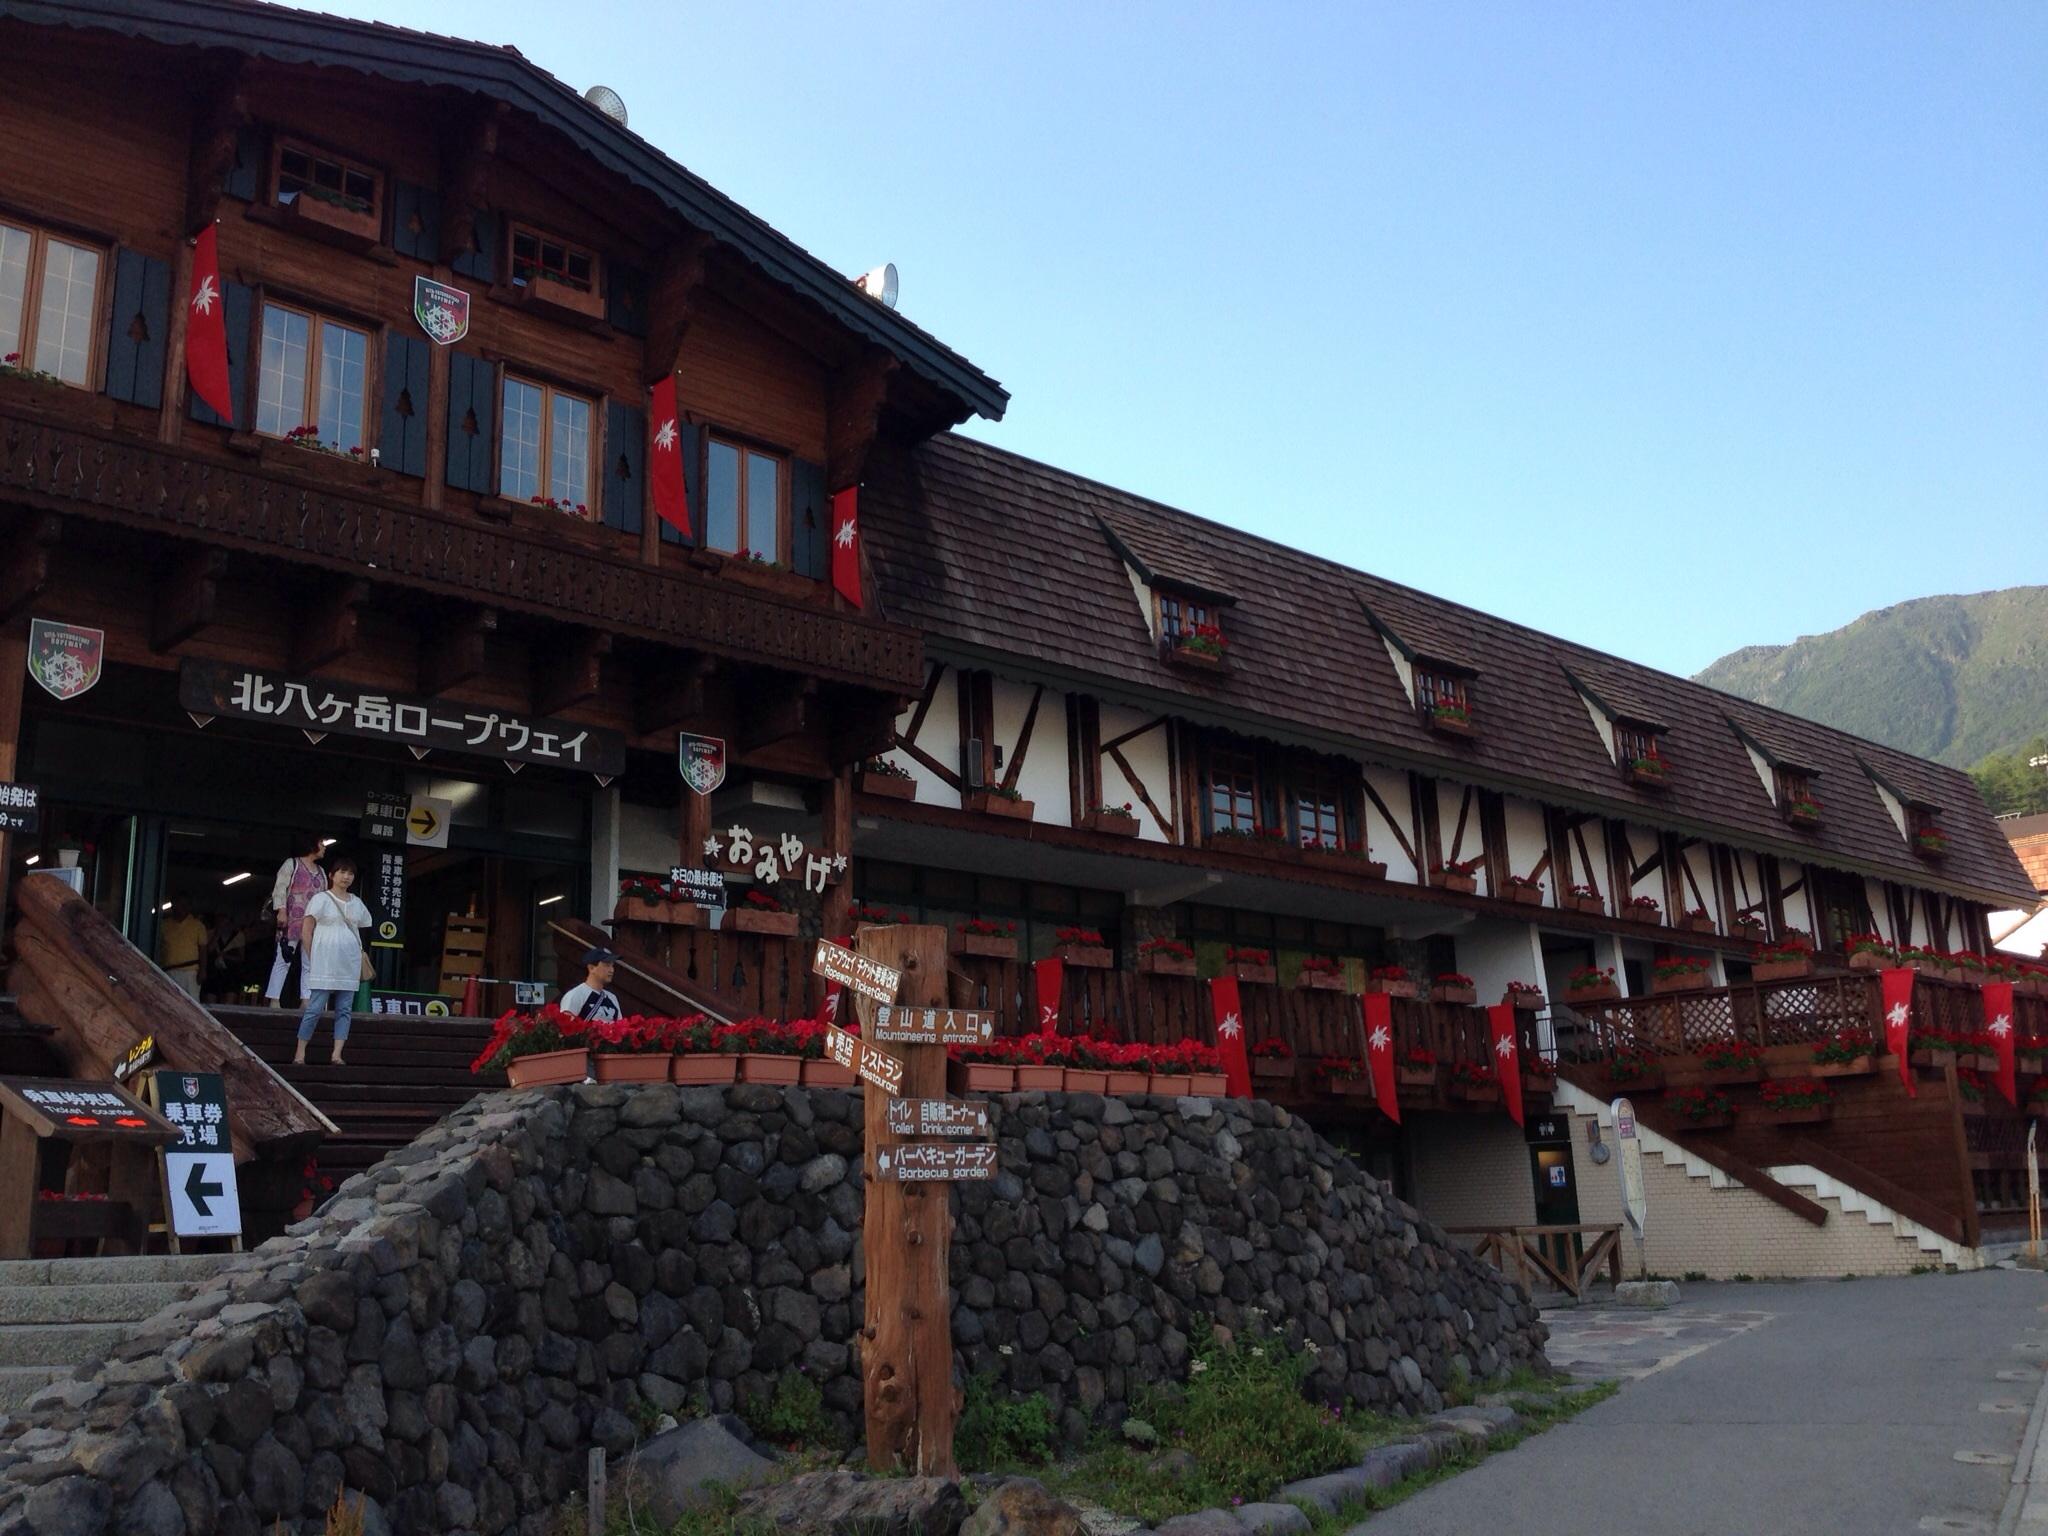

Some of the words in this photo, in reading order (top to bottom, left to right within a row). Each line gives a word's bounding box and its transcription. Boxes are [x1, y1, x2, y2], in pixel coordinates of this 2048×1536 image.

[50, 638, 83, 649] ROPEWAY
[728, 824, 832, 894] おみやげ
[391, 855, 403, 918] 乗車券売場は
[671, 867, 724, 887] 本日の最終便は
[828, 946, 857, 972] ロープウェイ
[824, 964, 852, 986] Ropeway
[876, 1006, 979, 1032] 登山道入口
[875, 1028, 937, 1043] Mountaineering
[942, 1033, 978, 1043] entrance
[836, 1032, 854, 1058] 売店
[861, 1045, 903, 1080] レストラン
[834, 1050, 851, 1067] Shop
[860, 1064, 898, 1095] Restaurant
[22, 1089, 126, 1107] 乗車券売場
[165, 1102, 223, 1124] 乗車券
[889, 1100, 912, 1120] トイレ
[921, 1101, 976, 1122] 自販機コーナー
[177, 1124, 218, 1145] 売場
[889, 1122, 915, 1134] Toilet
[921, 1123, 944, 1134] Drink
[946, 1125, 974, 1135] corner
[894, 1146, 996, 1165] バーベキューガーデン
[899, 1167, 949, 1179] Barbecue
[953, 1165, 988, 1180] garden
